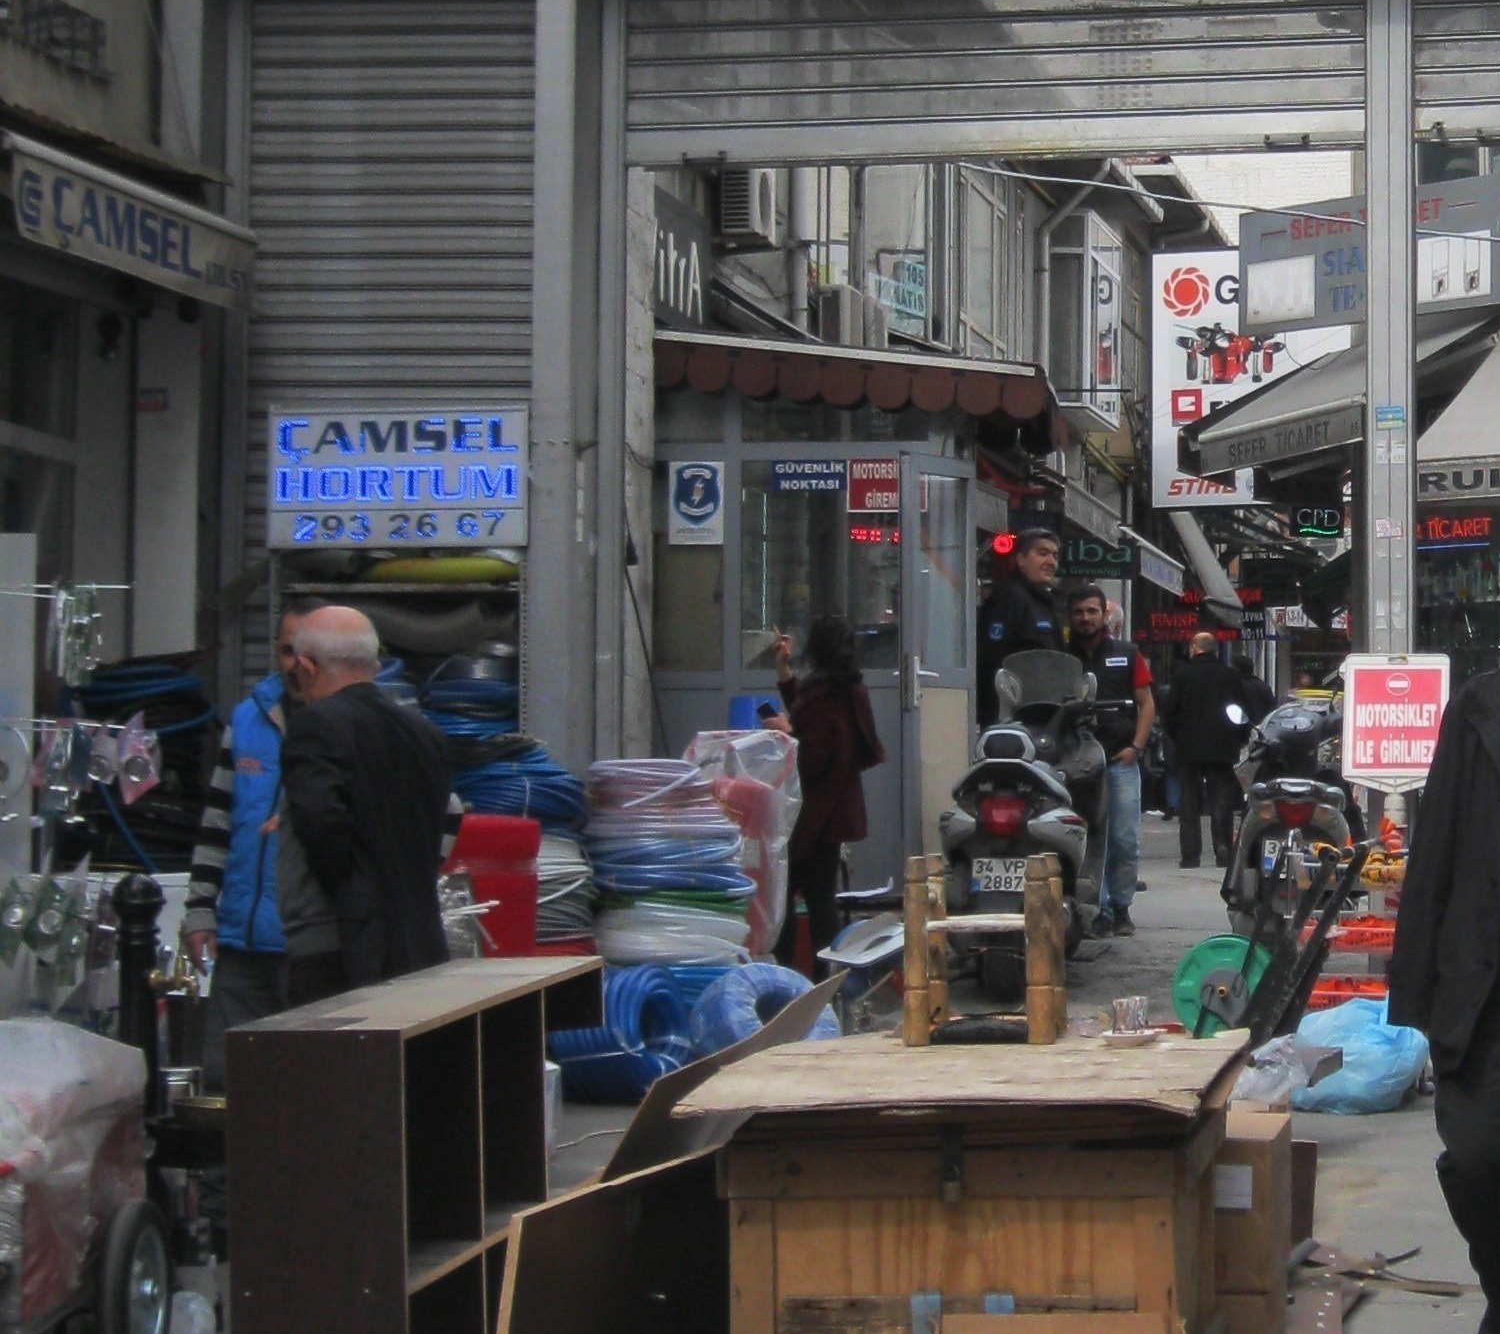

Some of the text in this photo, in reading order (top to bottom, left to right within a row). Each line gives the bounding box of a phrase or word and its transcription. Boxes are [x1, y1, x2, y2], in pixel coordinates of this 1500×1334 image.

[52, 176, 201, 280] ÇAMSEL
[1214, 274, 1239, 305] G
[276, 416, 519, 465] ÇAMSEL
[775, 461, 845, 475] GÜVENLİK
[853, 460, 899, 480] MOTORSİ
[274, 462, 519, 504] HORTUM
[780, 479, 840, 491] NOKTASI
[865, 488, 899, 509] GİREM
[294, 510, 505, 542] 293 26 67
[1297, 508, 1341, 528] CPD
[1427, 516, 1491, 541] TİCARET
[1067, 539, 1132, 563] iba
[1356, 698, 1437, 728] MOTORSİKLET
[1356, 733, 1435, 764] İLE GİRİLMEZ
[975, 860, 1026, 874] 34 VP
[983, 876, 1024, 890] 2887
